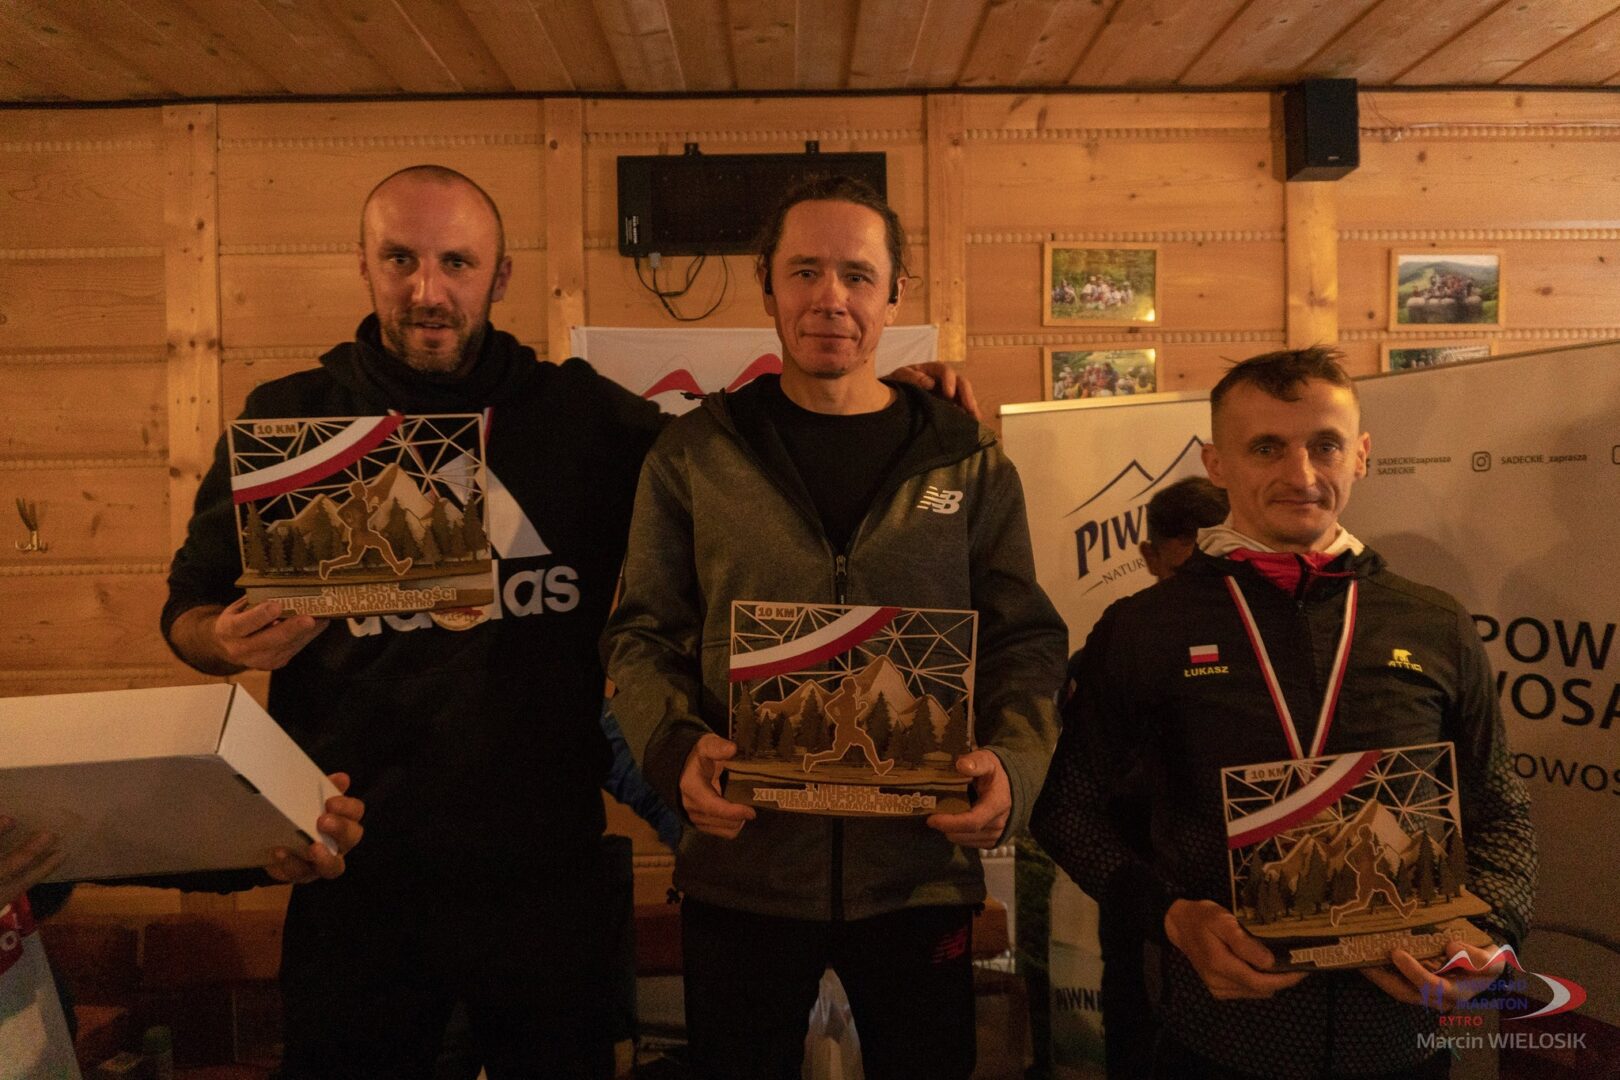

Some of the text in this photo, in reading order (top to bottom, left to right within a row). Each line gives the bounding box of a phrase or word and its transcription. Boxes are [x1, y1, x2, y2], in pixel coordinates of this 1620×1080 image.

[256, 423, 297, 435] 10 KM
[1074, 502, 1150, 580] PIW
[293, 597, 326, 608] BIEG
[757, 607, 796, 618] 10 KM
[1184, 666, 1229, 677] ŁUKASZ
[1251, 770, 1265, 779] 10
